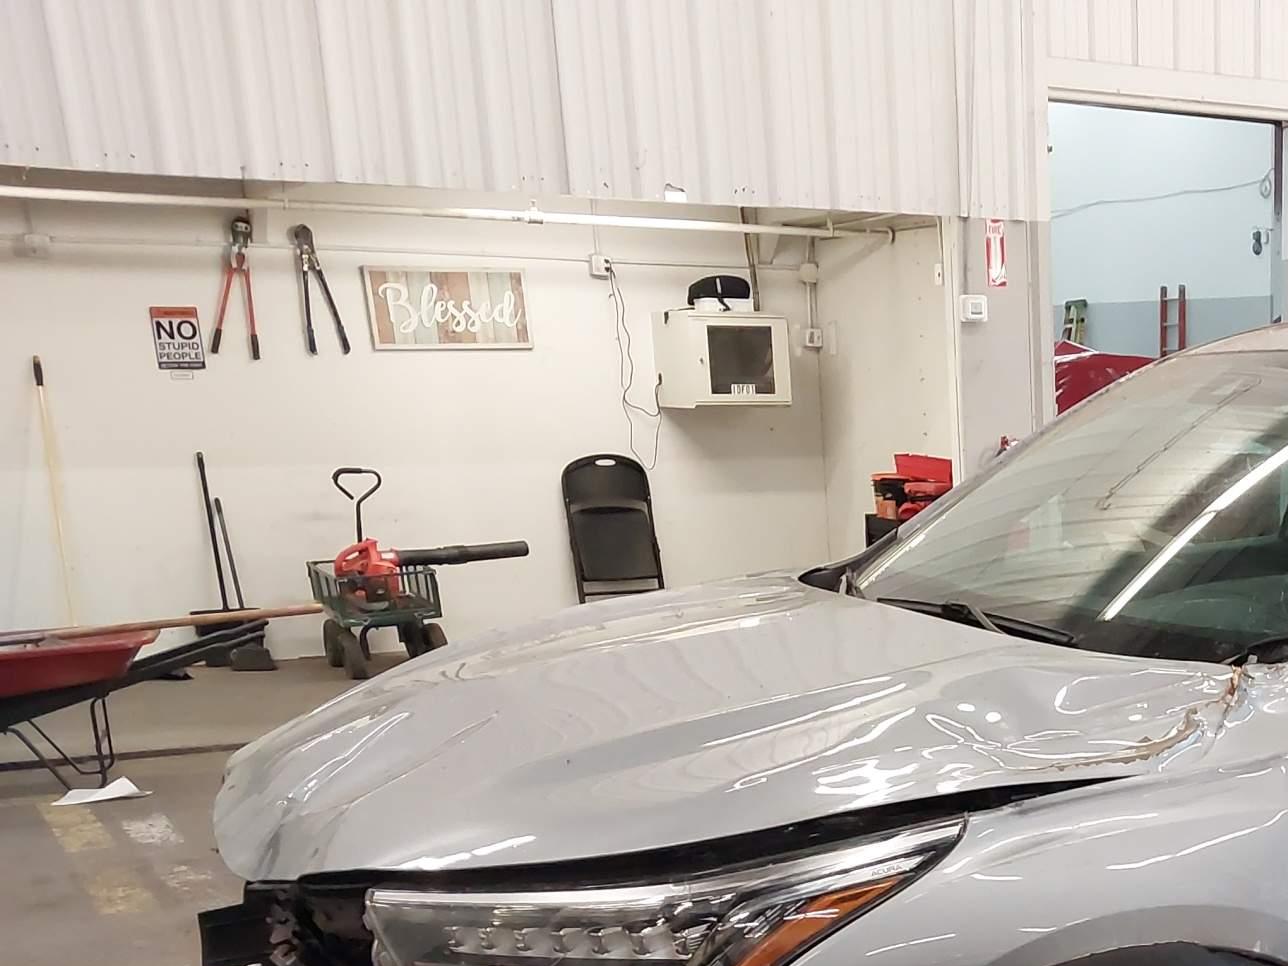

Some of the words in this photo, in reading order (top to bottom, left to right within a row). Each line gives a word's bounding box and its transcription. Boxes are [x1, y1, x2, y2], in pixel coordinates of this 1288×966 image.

[378, 282, 522, 333] Blessed
[155, 320, 197, 340] NO
[158, 341, 200, 351] STUPID
[158, 351, 201, 361] PEOPLE
